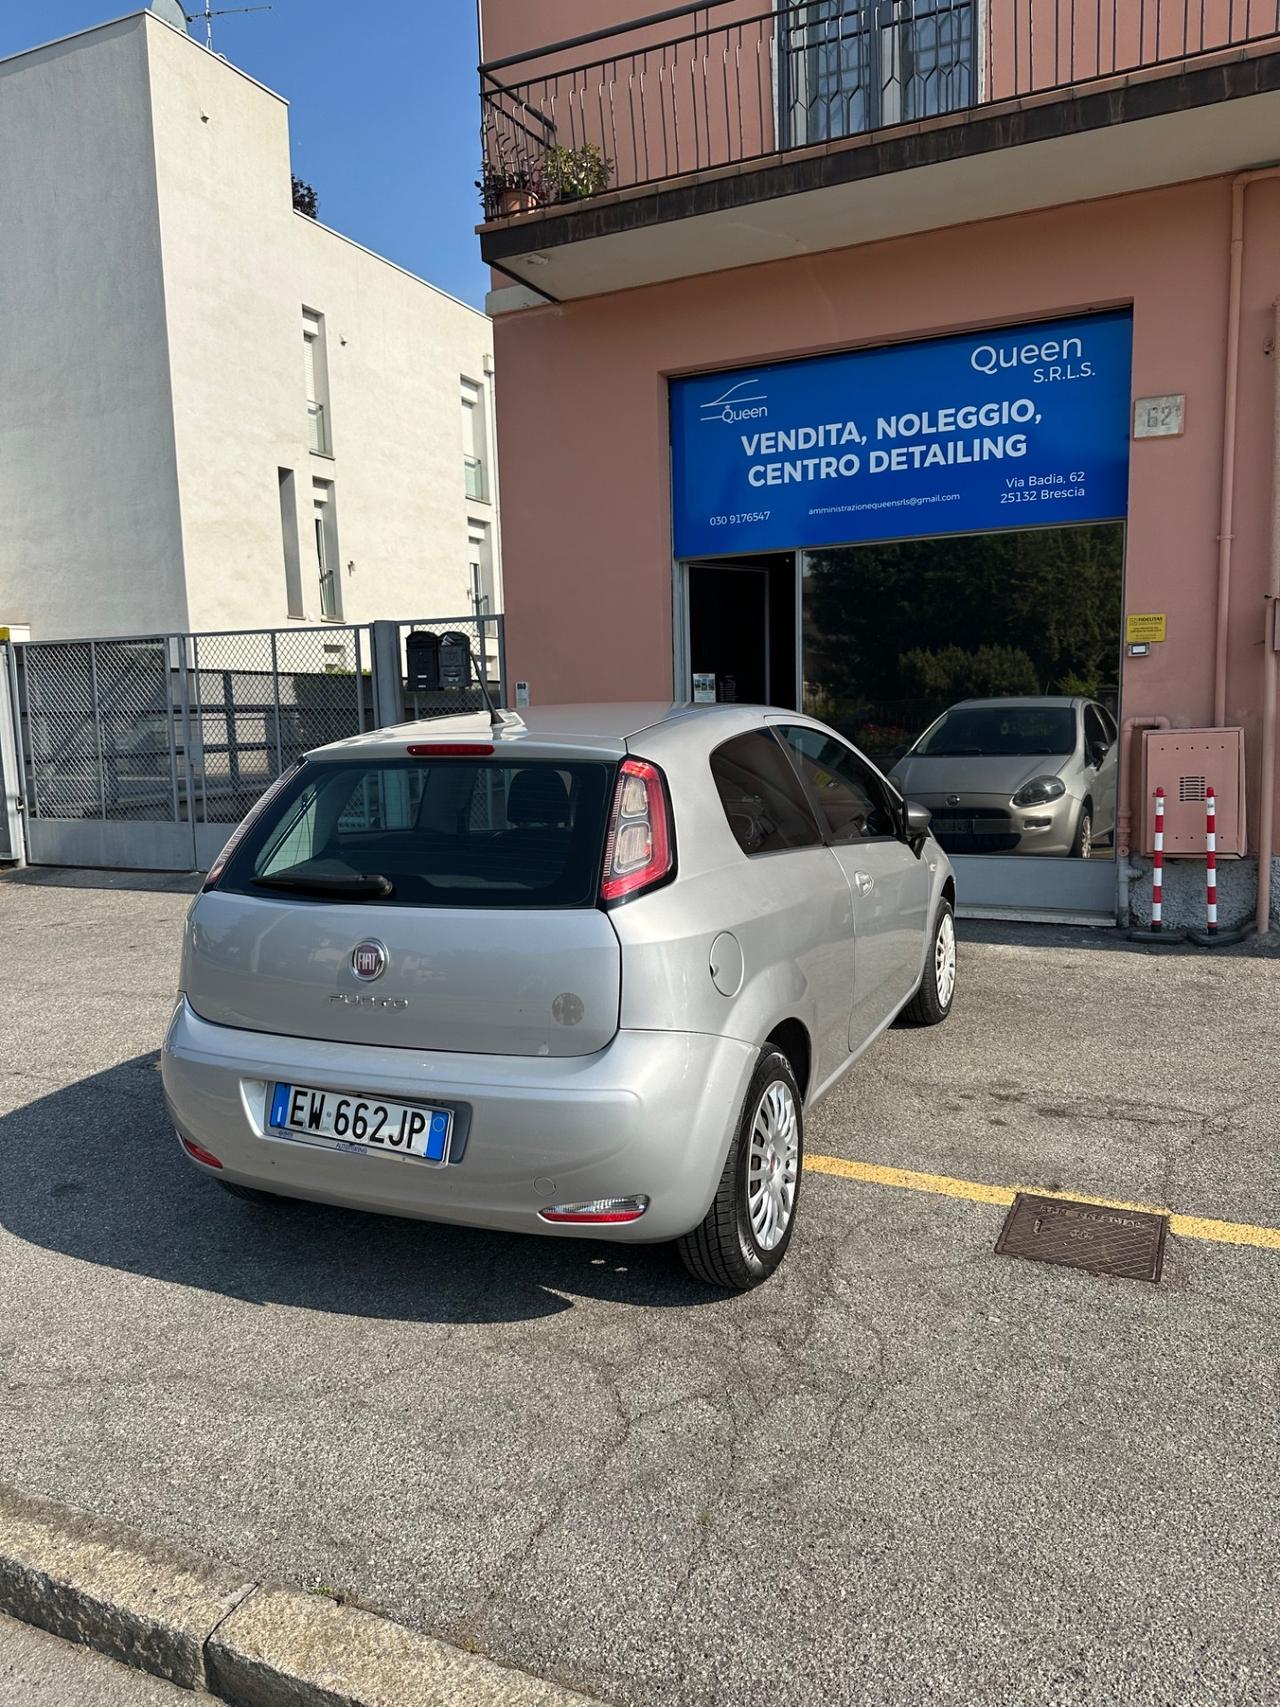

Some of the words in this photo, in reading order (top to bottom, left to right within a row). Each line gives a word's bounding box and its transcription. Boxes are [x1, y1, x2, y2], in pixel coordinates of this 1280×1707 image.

[971, 337, 1082, 375] Queen
[1033, 362, 1096, 383] S.R.L.S.
[722, 406, 768, 424] Queen
[741, 421, 867, 456] VENDITA,
[876, 399, 1042, 440] NOLEGGIO,
[749, 454, 860, 487] CENTRO
[869, 434, 1027, 473] DETAILING
[1006, 477, 1025, 489] Via
[1028, 474, 1066, 487] Badia,
[1069, 471, 1085, 482] 62
[808, 493, 960, 516] amministrazionequeensrls@gmail.com
[1001, 491, 1038, 504] 25132
[1041, 487, 1085, 500] Brescia
[710, 515, 728, 526] 030
[730, 511, 771, 524] 9176547
[358, 952, 378, 970] FIAT
[289, 1090, 326, 1131] EW
[334, 1100, 426, 1149] 662JP
